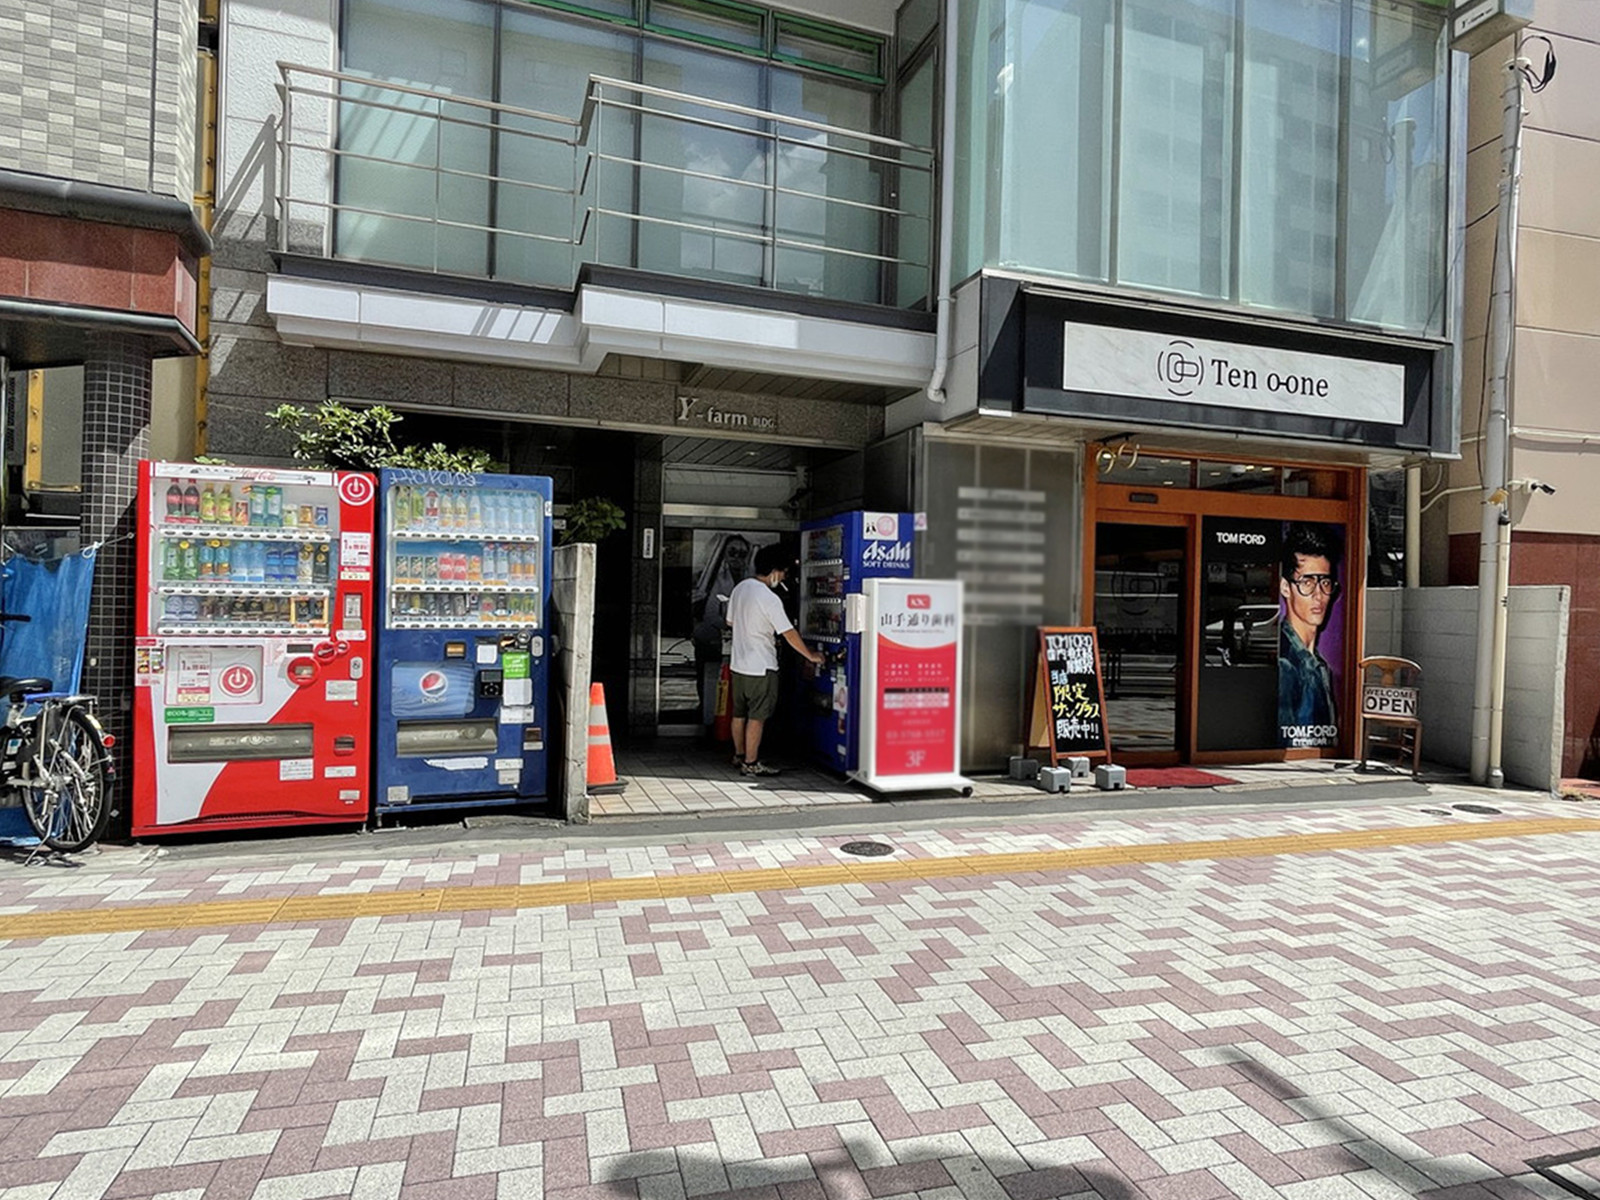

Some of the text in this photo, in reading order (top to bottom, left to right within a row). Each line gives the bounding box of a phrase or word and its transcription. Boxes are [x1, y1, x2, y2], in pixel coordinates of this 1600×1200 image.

[1211, 358, 1258, 390] Ten
[1216, 532, 1266, 545] TOM FORD
[862, 540, 911, 561] Asahi
[862, 560, 911, 569] SOFT DRINKS
[1053, 682, 1090, 703] 限定
[1365, 688, 1416, 700] WELCOME
[1052, 700, 1101, 719] サングラス
[1365, 696, 1416, 714] OPEN
[1280, 724, 1338, 739] TOM FORD
[904, 749, 926, 768] 3F
